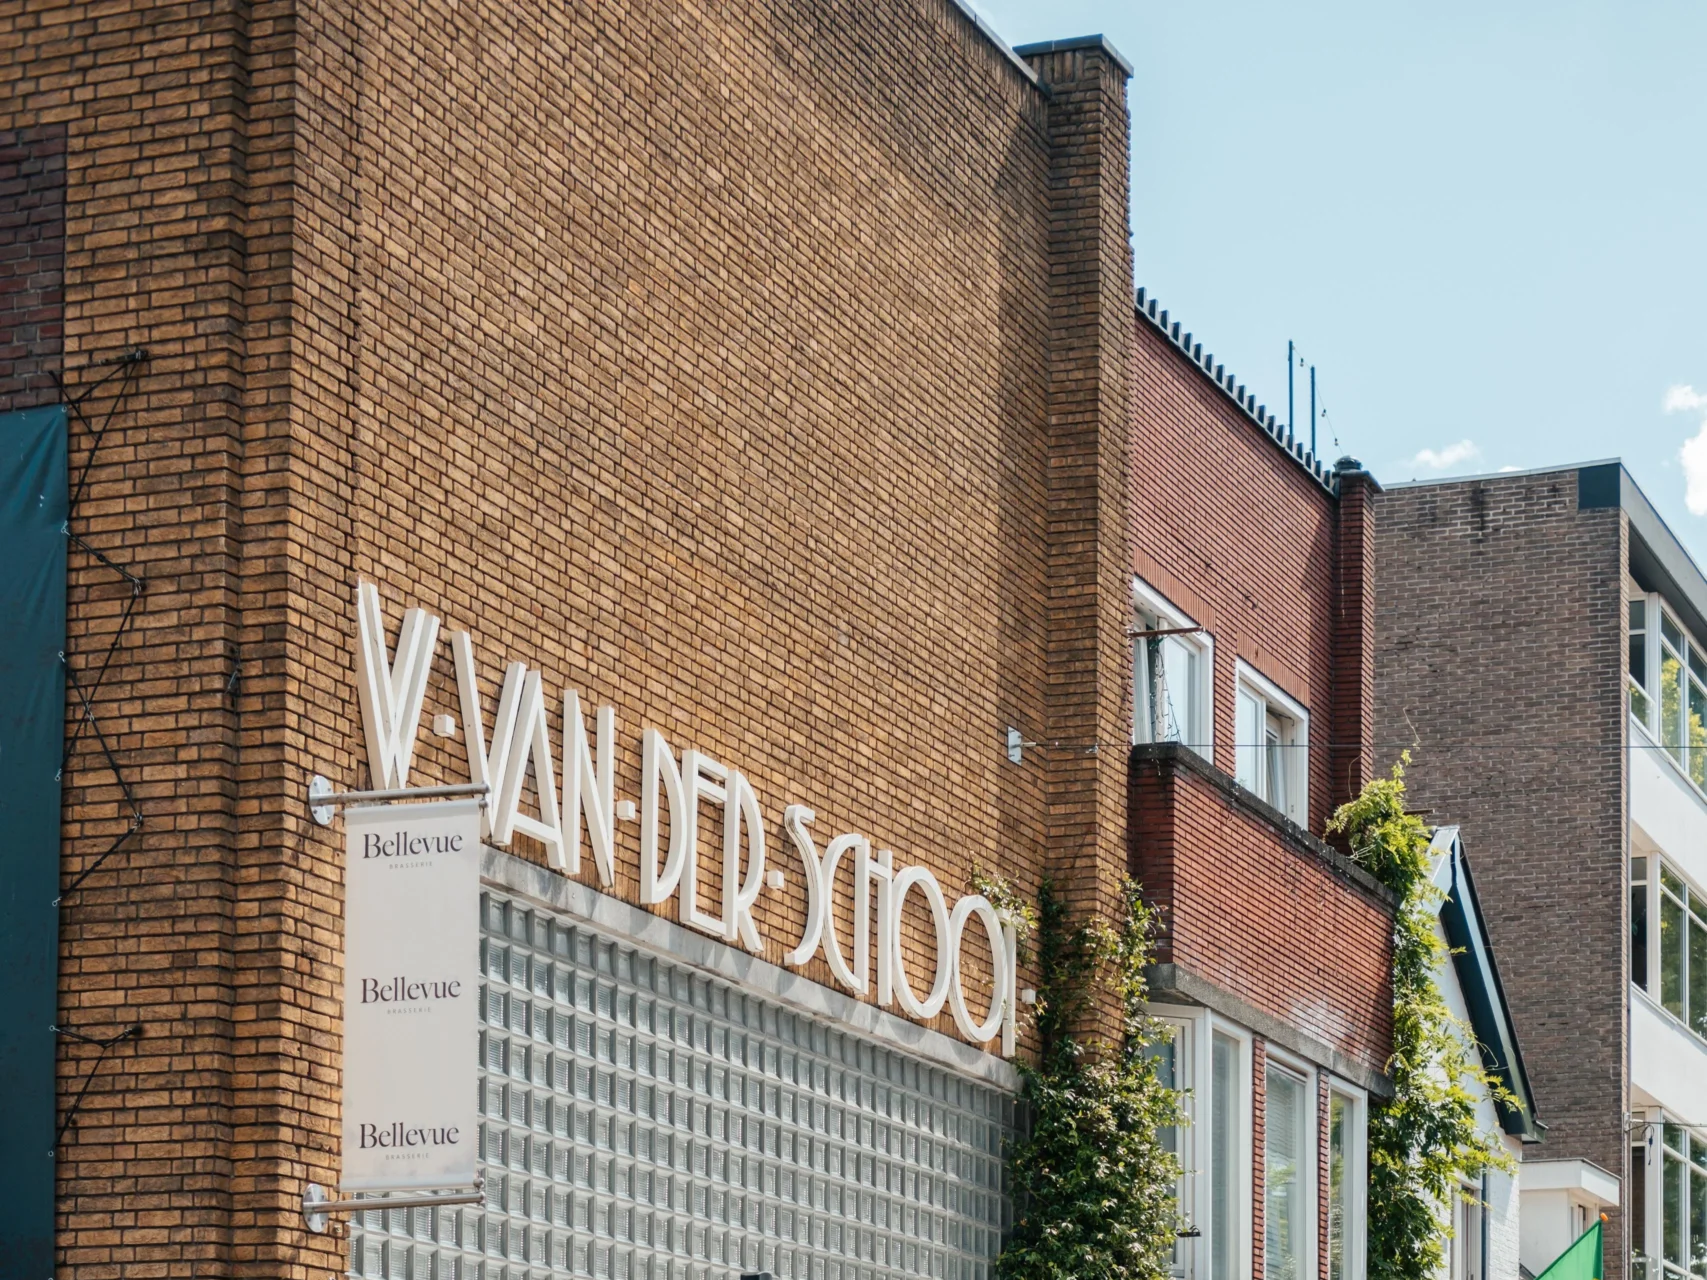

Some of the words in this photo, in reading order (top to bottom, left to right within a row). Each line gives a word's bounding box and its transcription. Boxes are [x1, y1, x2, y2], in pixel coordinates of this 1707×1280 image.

[451, 631, 614, 888] VAN
[640, 728, 765, 953] DER
[362, 831, 464, 860] Bellevue
[388, 861, 434, 870] BRASSERIE
[360, 976, 462, 1004] Bellevue
[387, 1006, 432, 1015] BRASSERIE
[359, 1121, 461, 1149] Bellevue
[385, 1152, 430, 1161] BRASSERIE
